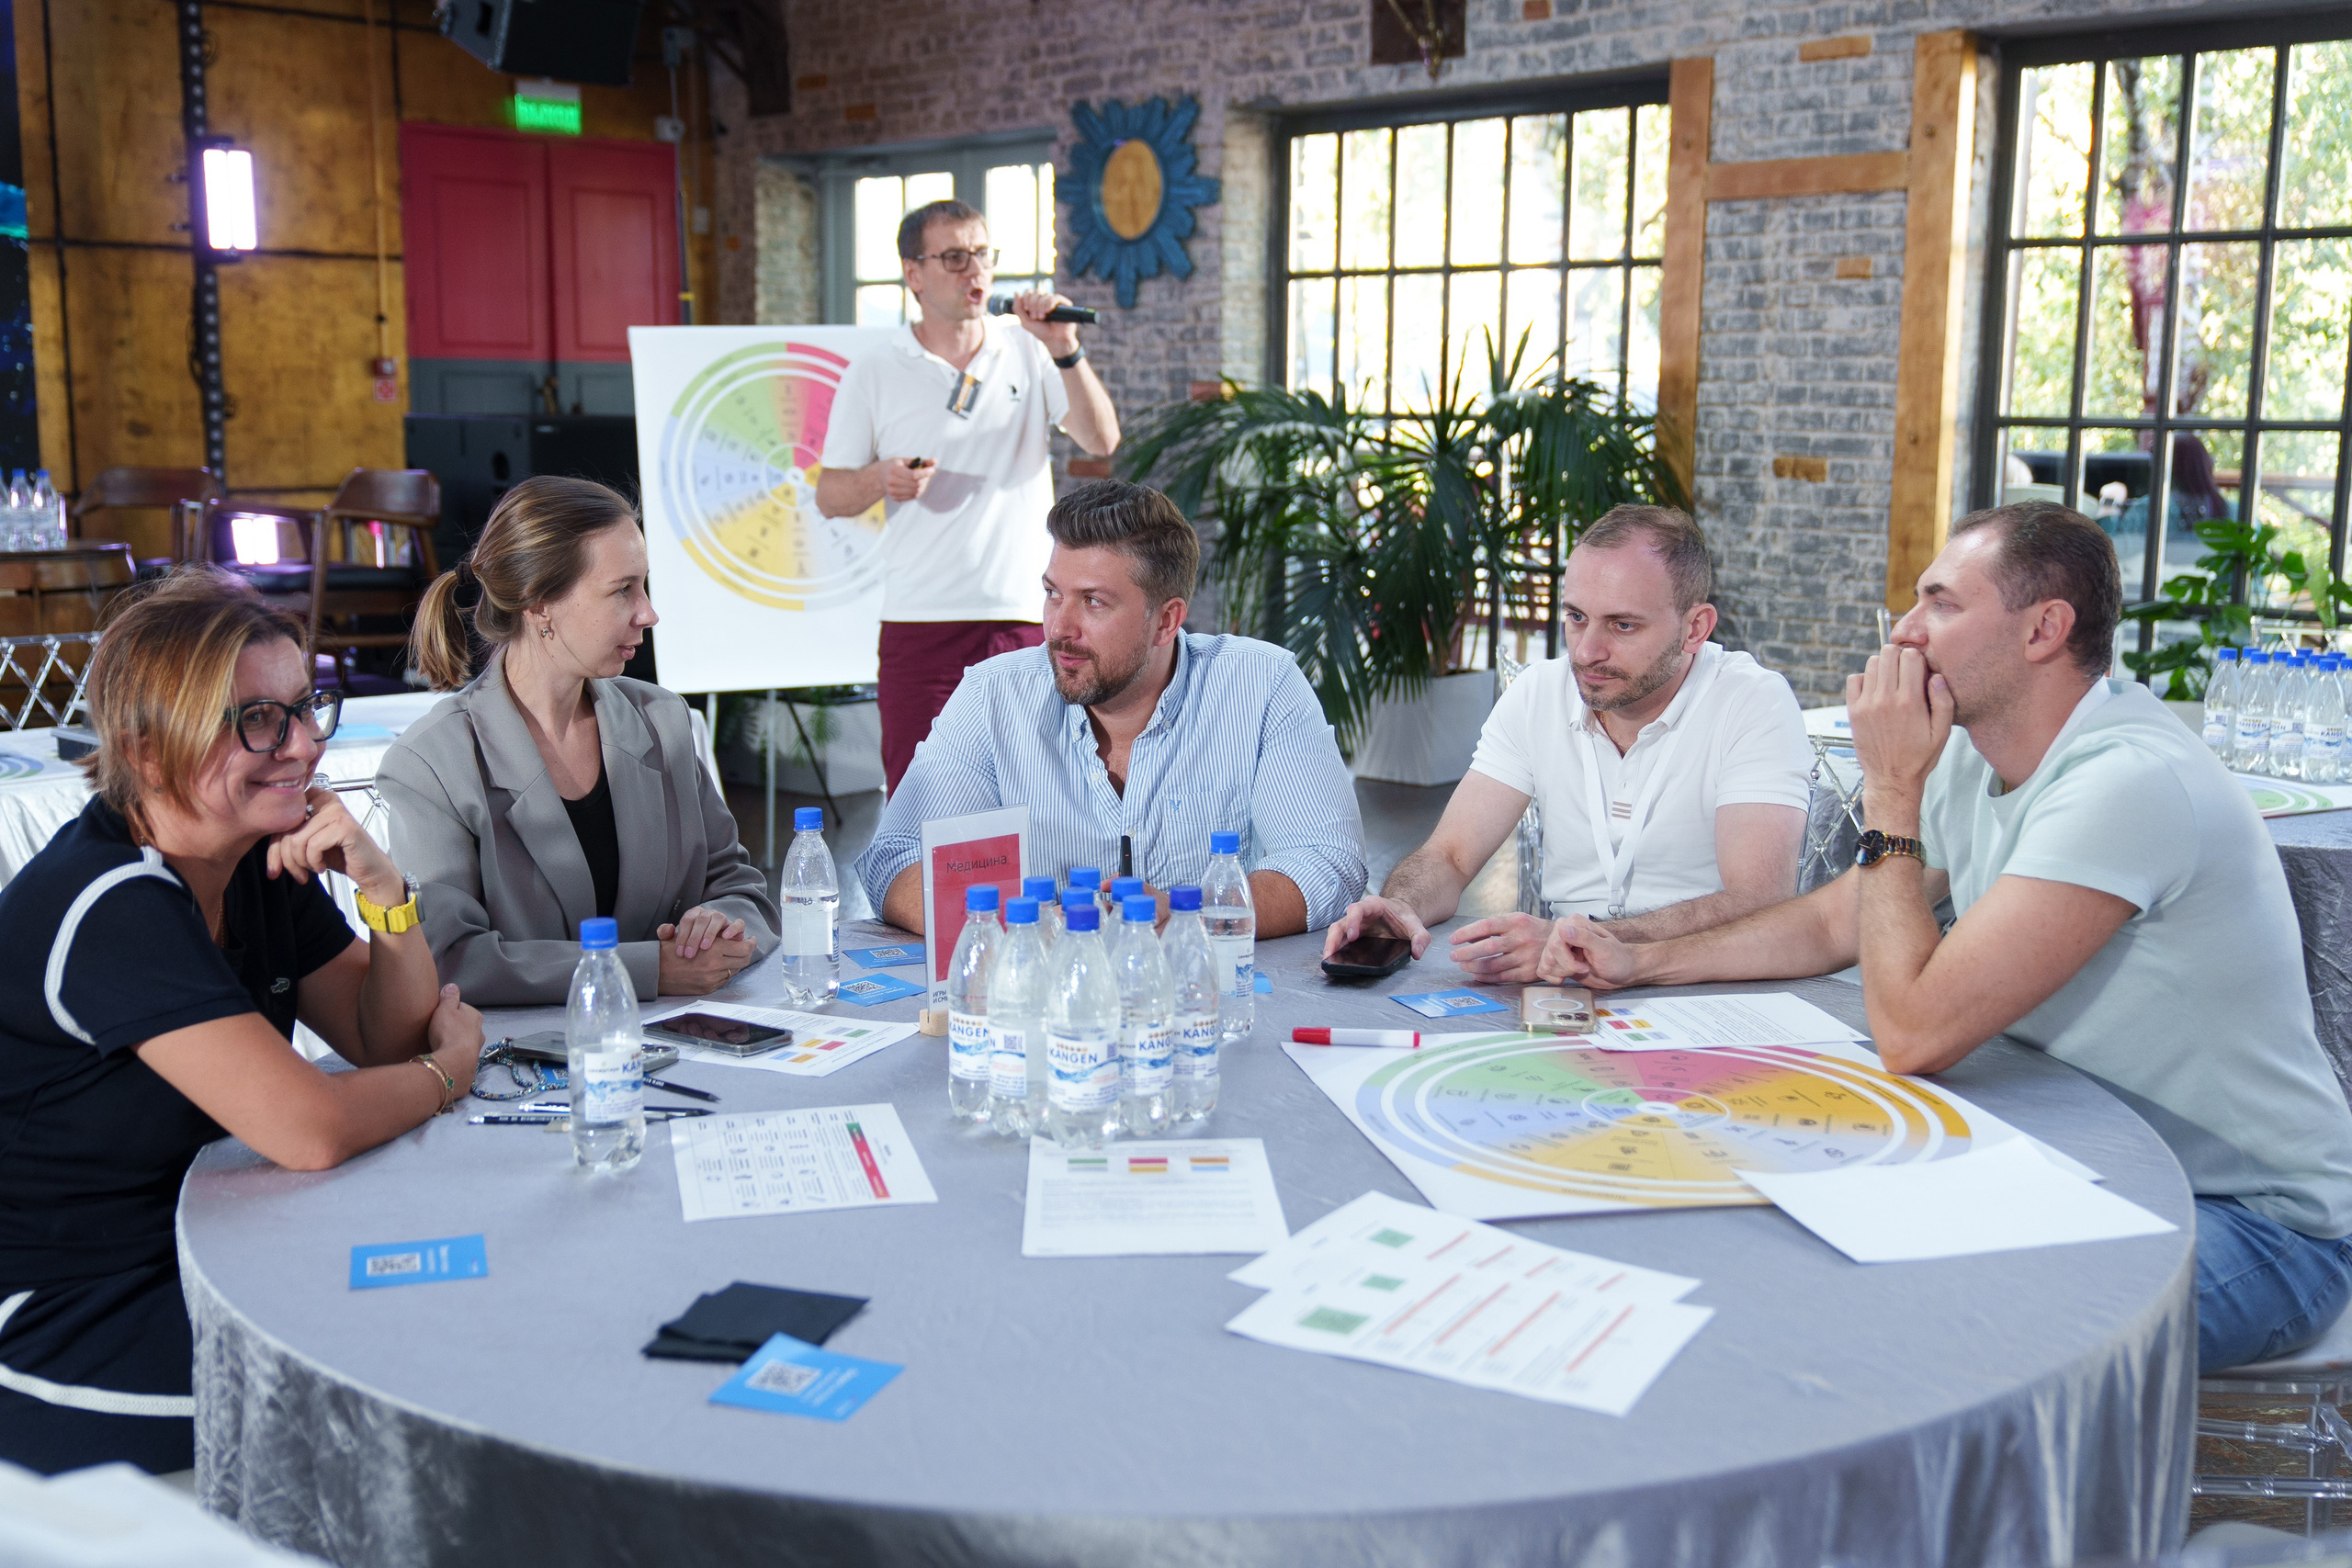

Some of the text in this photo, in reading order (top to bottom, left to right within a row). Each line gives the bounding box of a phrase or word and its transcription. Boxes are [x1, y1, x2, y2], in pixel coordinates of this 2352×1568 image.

[946, 854, 1007, 874] Медицина
[933, 989, 947, 998] ИГРЫ
[1182, 1024, 1216, 1039] KANG
[1138, 1035, 1173, 1051] KANG
[1049, 1047, 1098, 1064] KANGEN
